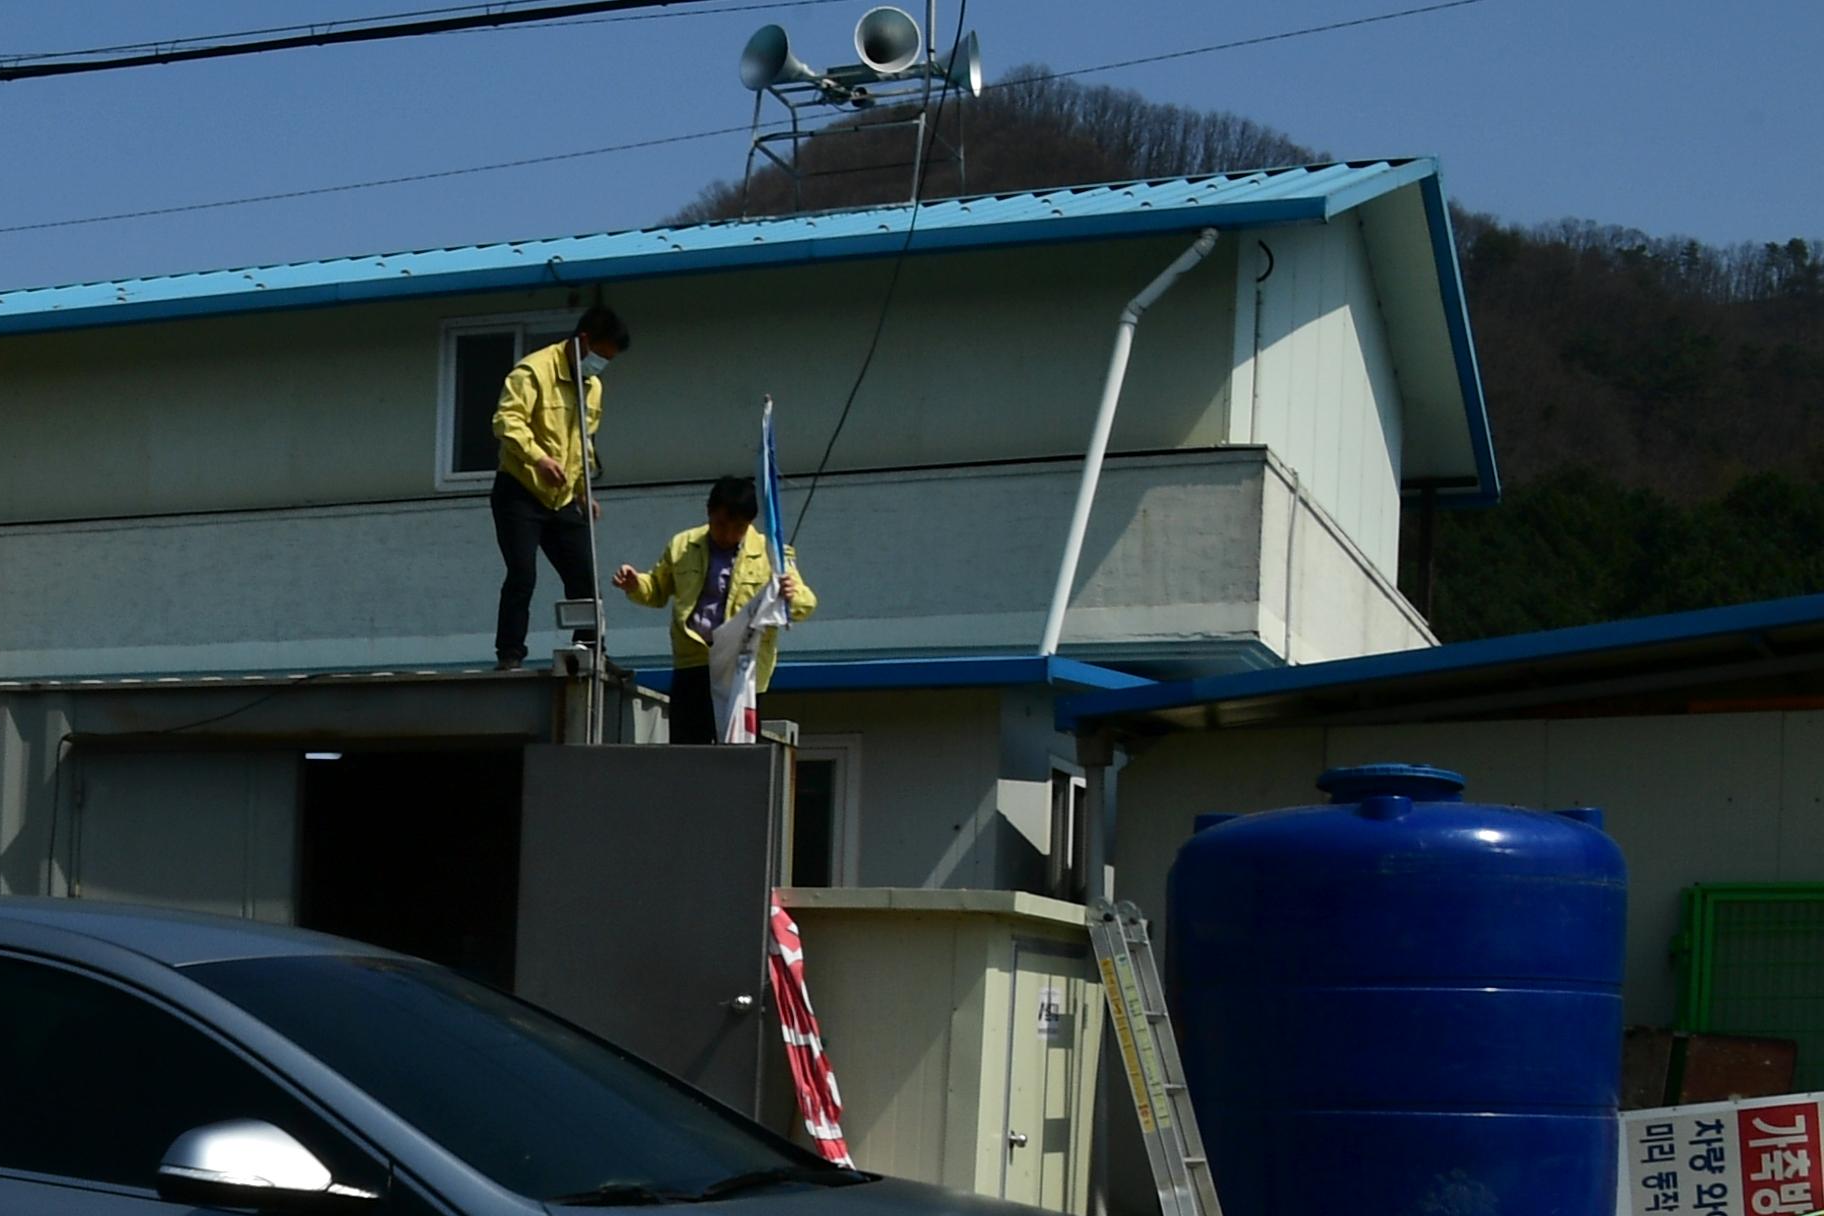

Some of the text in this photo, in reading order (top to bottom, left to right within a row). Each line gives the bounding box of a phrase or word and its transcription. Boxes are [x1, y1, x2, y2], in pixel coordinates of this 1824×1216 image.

[1640, 1123, 1675, 1164] 미리
[1689, 1119, 1725, 1174] 차량
[1642, 1171, 1680, 1212] 동작
